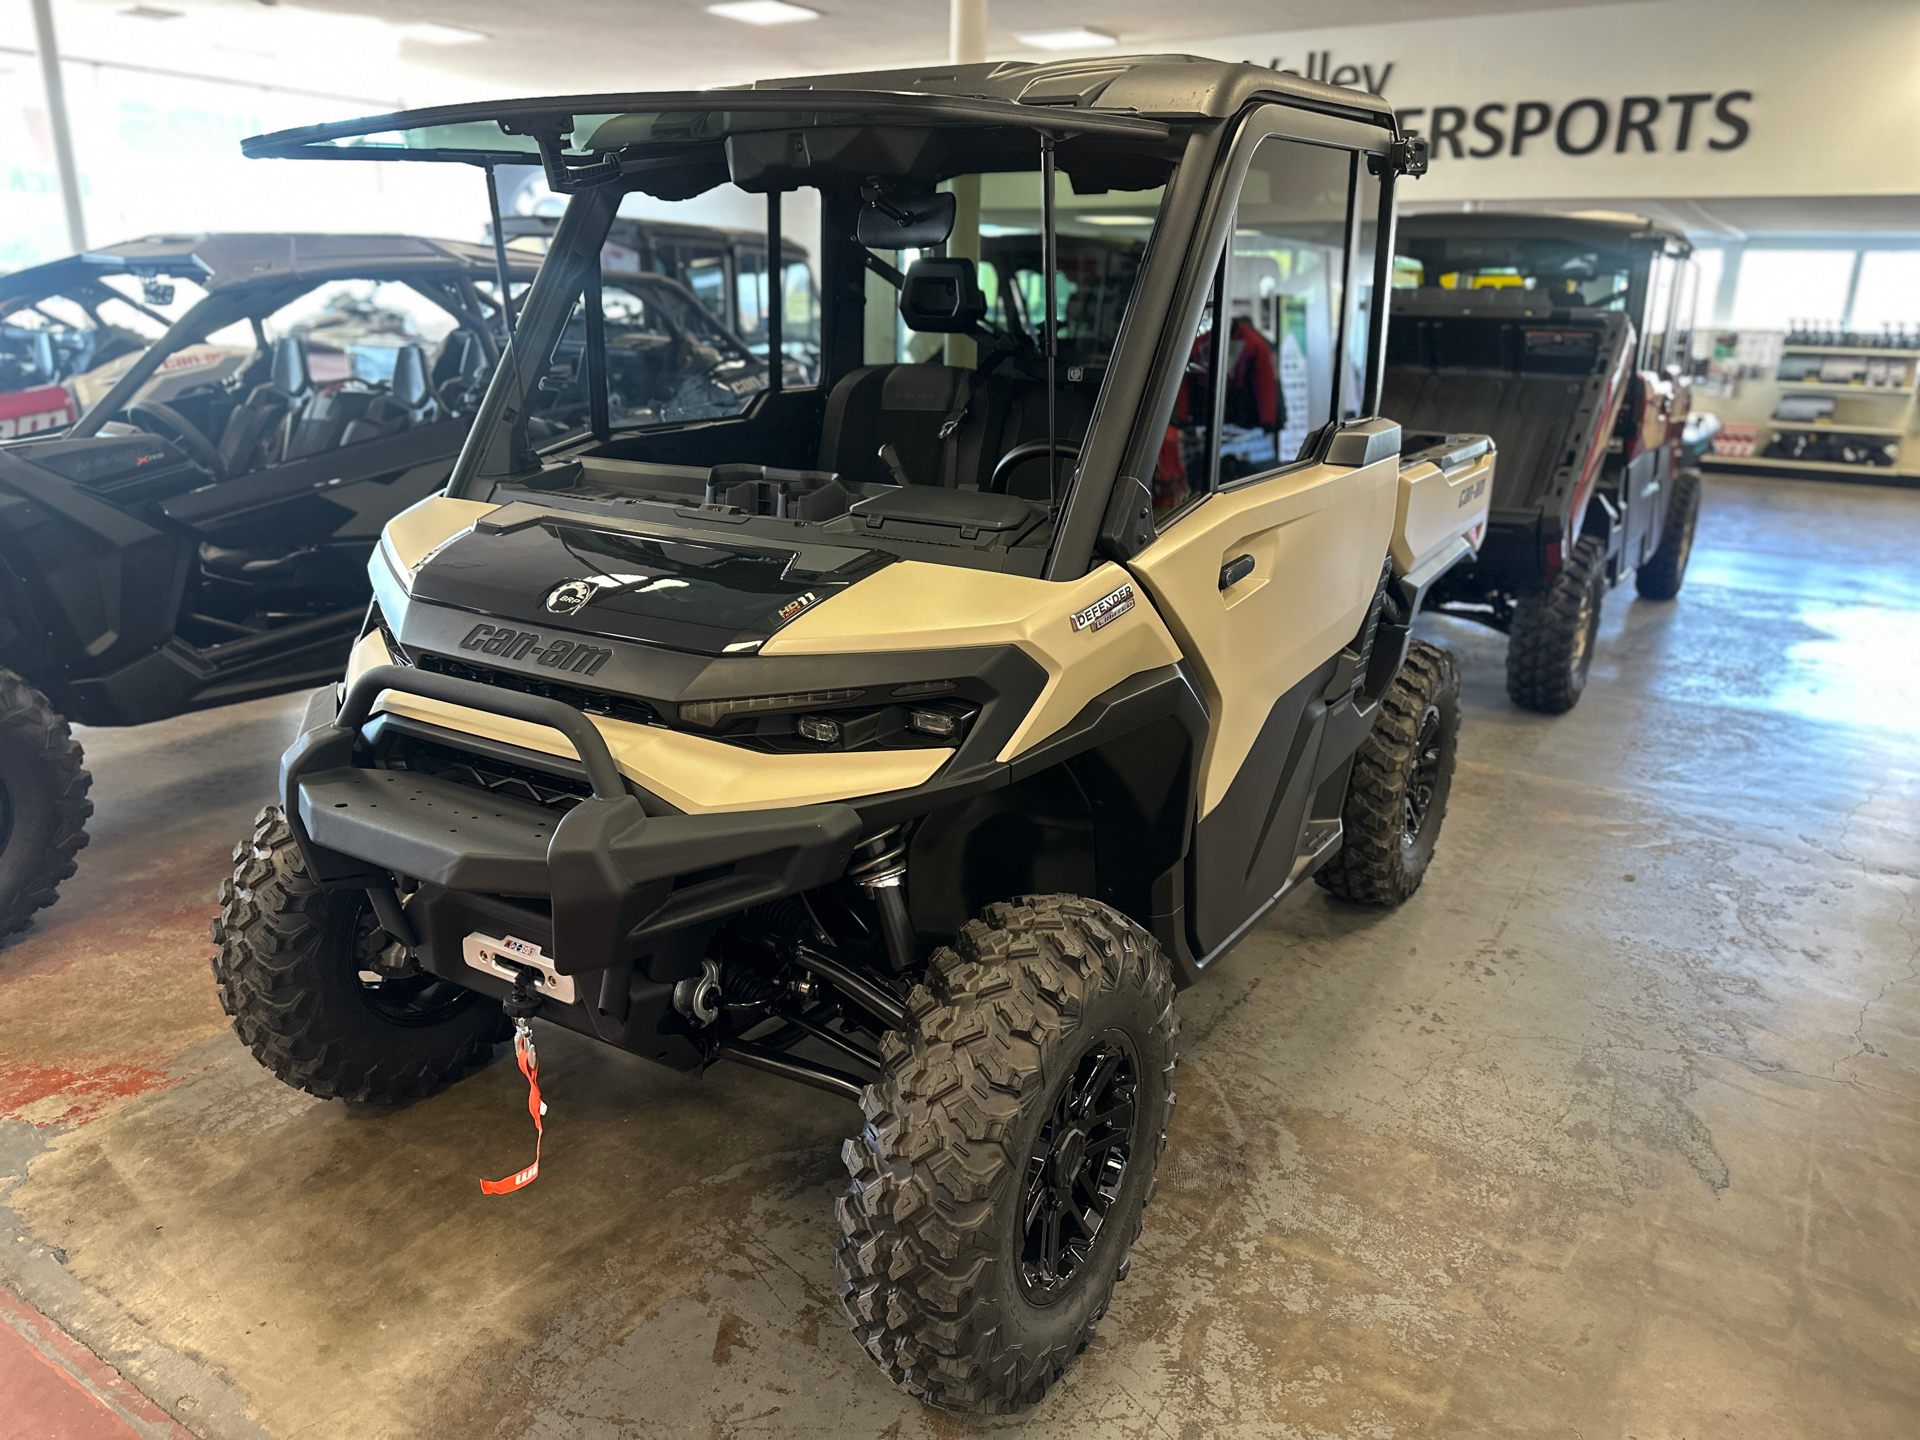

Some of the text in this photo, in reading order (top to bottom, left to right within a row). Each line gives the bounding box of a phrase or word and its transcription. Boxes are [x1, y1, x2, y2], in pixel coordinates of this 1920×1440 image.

[1268, 50, 1394, 96] lley
[559, 594, 582, 604] BRP
[1077, 585, 1133, 627] DEFENDER
[459, 623, 614, 677] can-am
